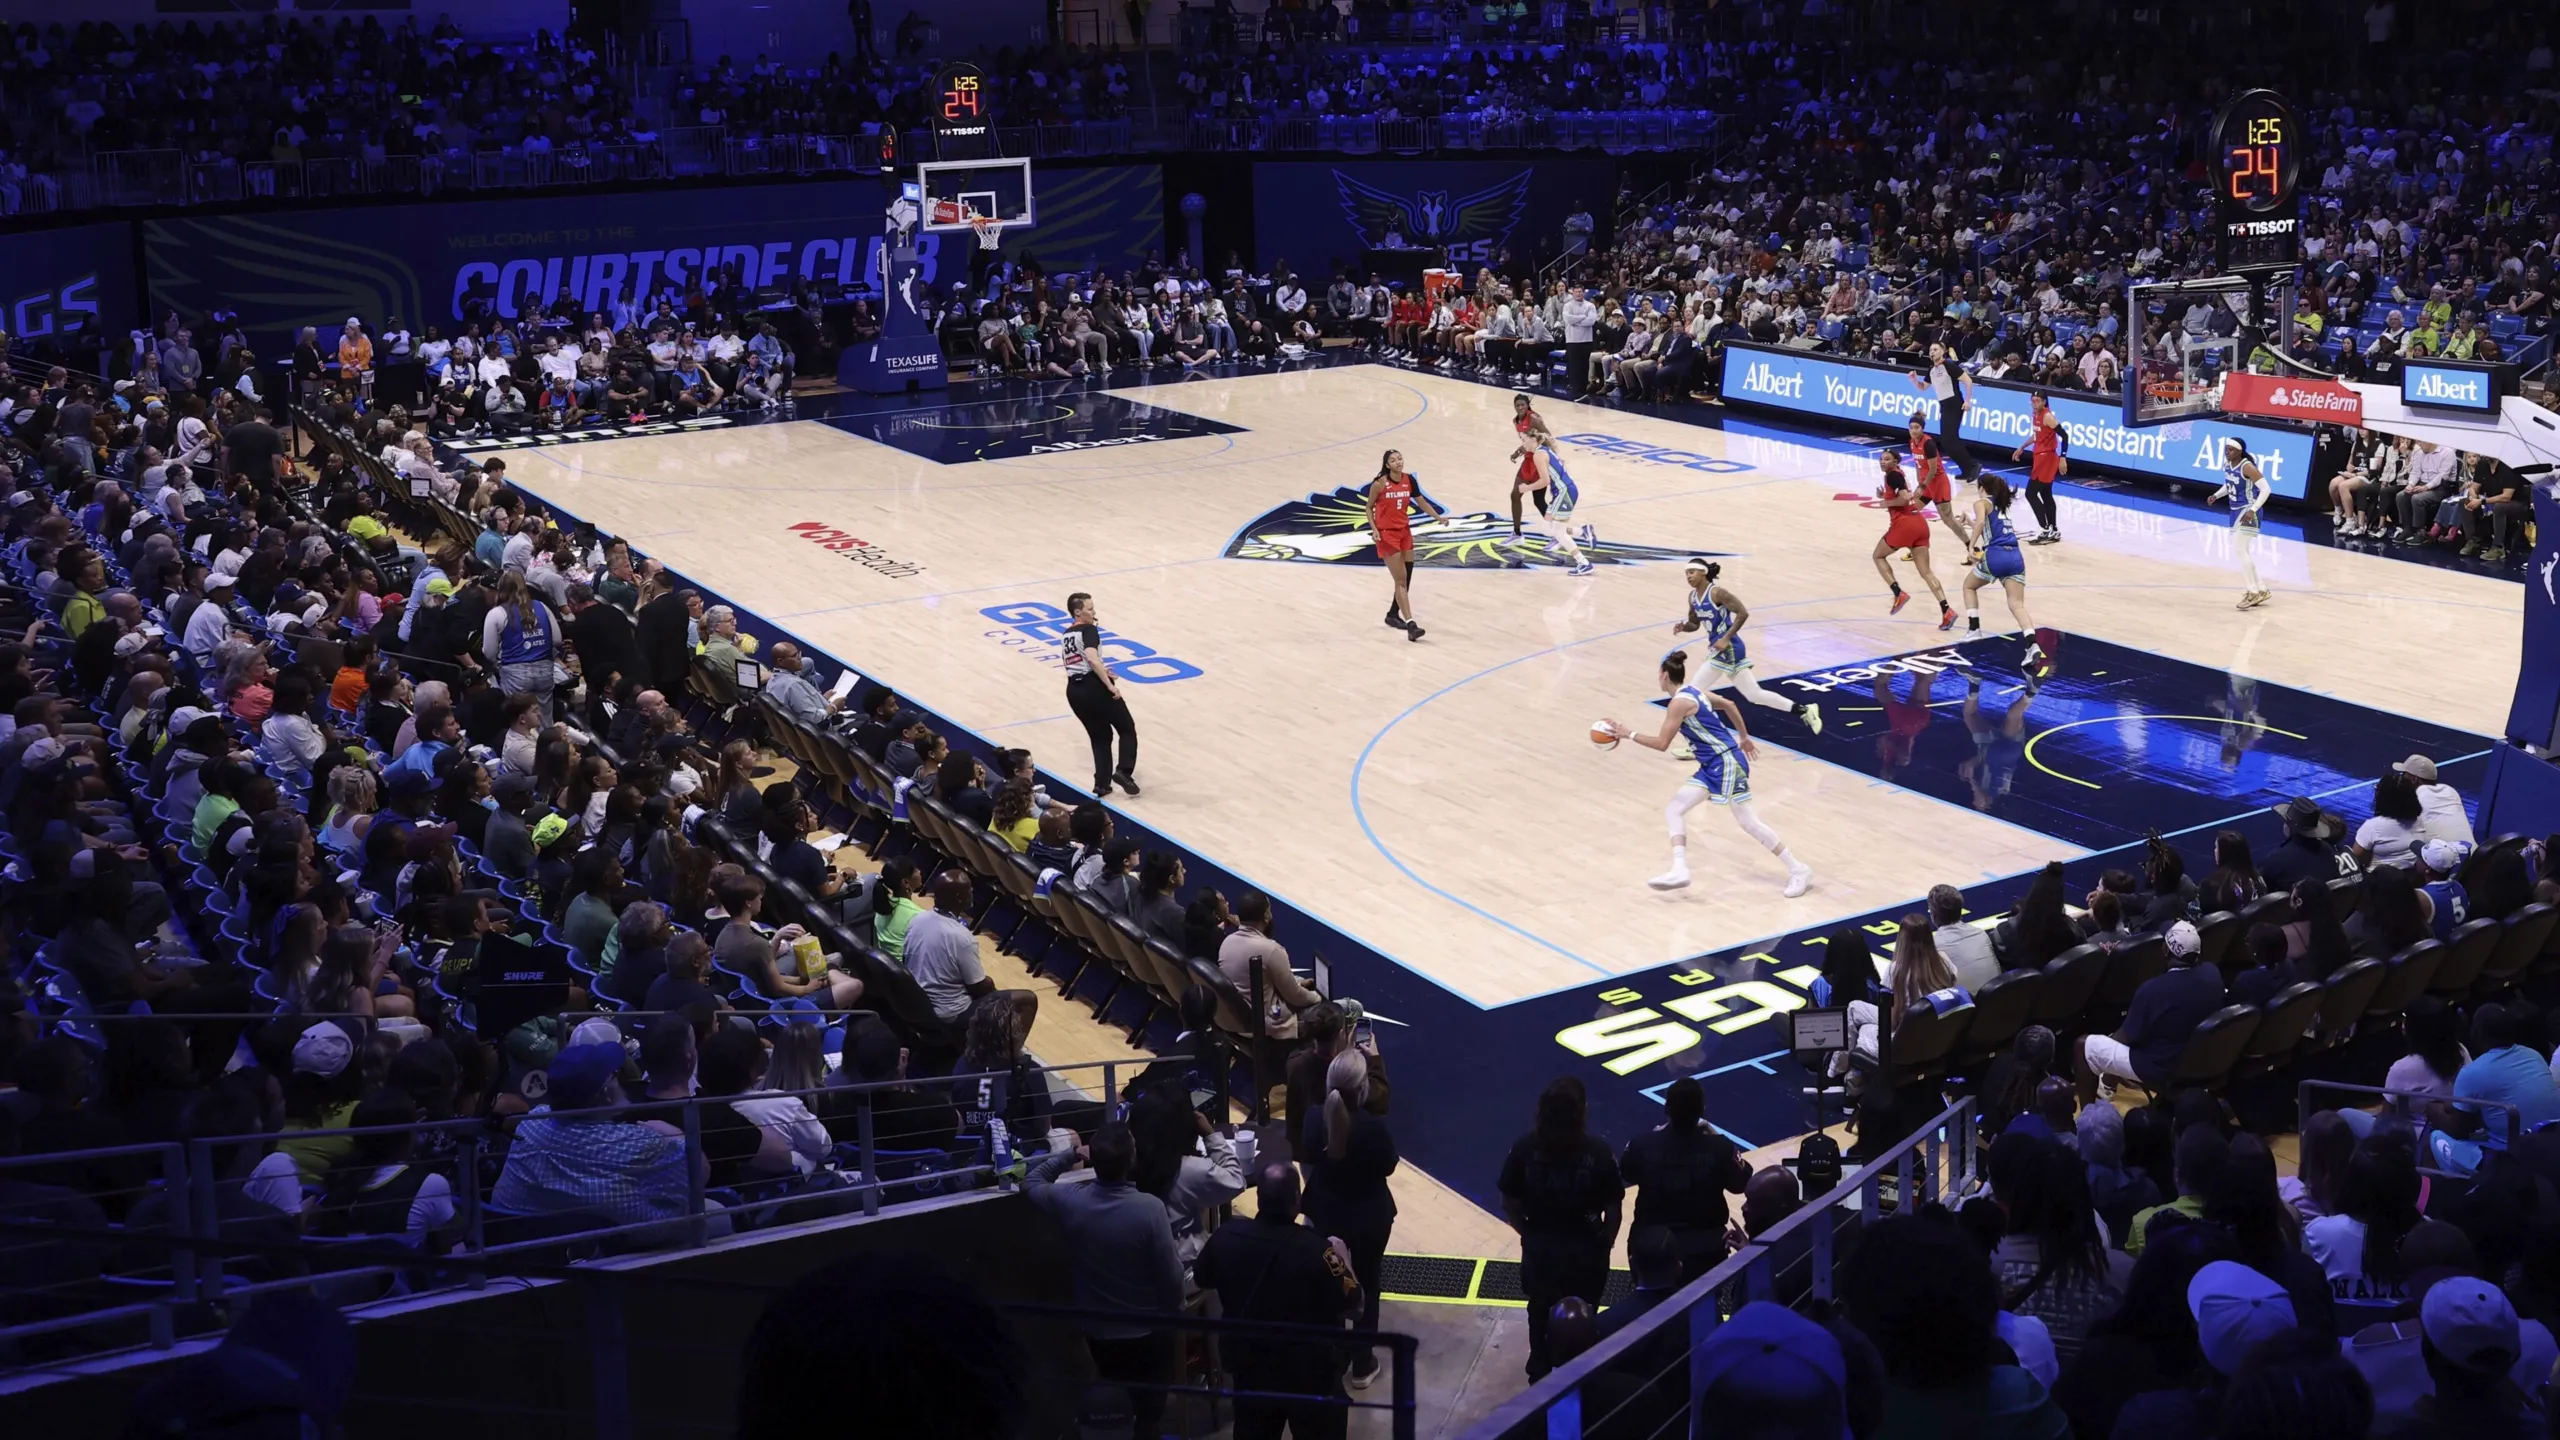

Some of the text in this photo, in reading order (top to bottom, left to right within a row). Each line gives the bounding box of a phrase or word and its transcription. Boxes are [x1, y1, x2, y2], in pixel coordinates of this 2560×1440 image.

[954, 76, 978, 91] 1:25
[944, 91, 977, 117] 24
[953, 127, 986, 136] TISSOT
[2248, 118, 2281, 145] 1:25
[2231, 147, 2277, 198] 24
[448, 226, 636, 249] WELCOME TO THE
[2247, 219, 2295, 236] TISSOT
[452, 233, 941, 322] COURTSIDE CLUB
[2416, 373, 2478, 402] Albert
[1743, 362, 1803, 399] Albert
[1824, 375, 1868, 407] Your
[1868, 387, 1942, 422] person
[1961, 398, 2034, 438] financ
[2192, 434, 2284, 482] Alrt
[1029, 434, 1165, 455] Albert
[1556, 432, 1757, 474] GEICO
[1385, 491, 1410, 499] ATLANTA
[979, 602, 1204, 684] GEICO
[1063, 636, 1078, 655] 33
[1781, 648, 1973, 693] Albert
[2334, 853, 2358, 876] 20
[2451, 896, 2466, 924] 5
[503, 971, 546, 981] SHURE
[978, 1078, 993, 1109] 5
